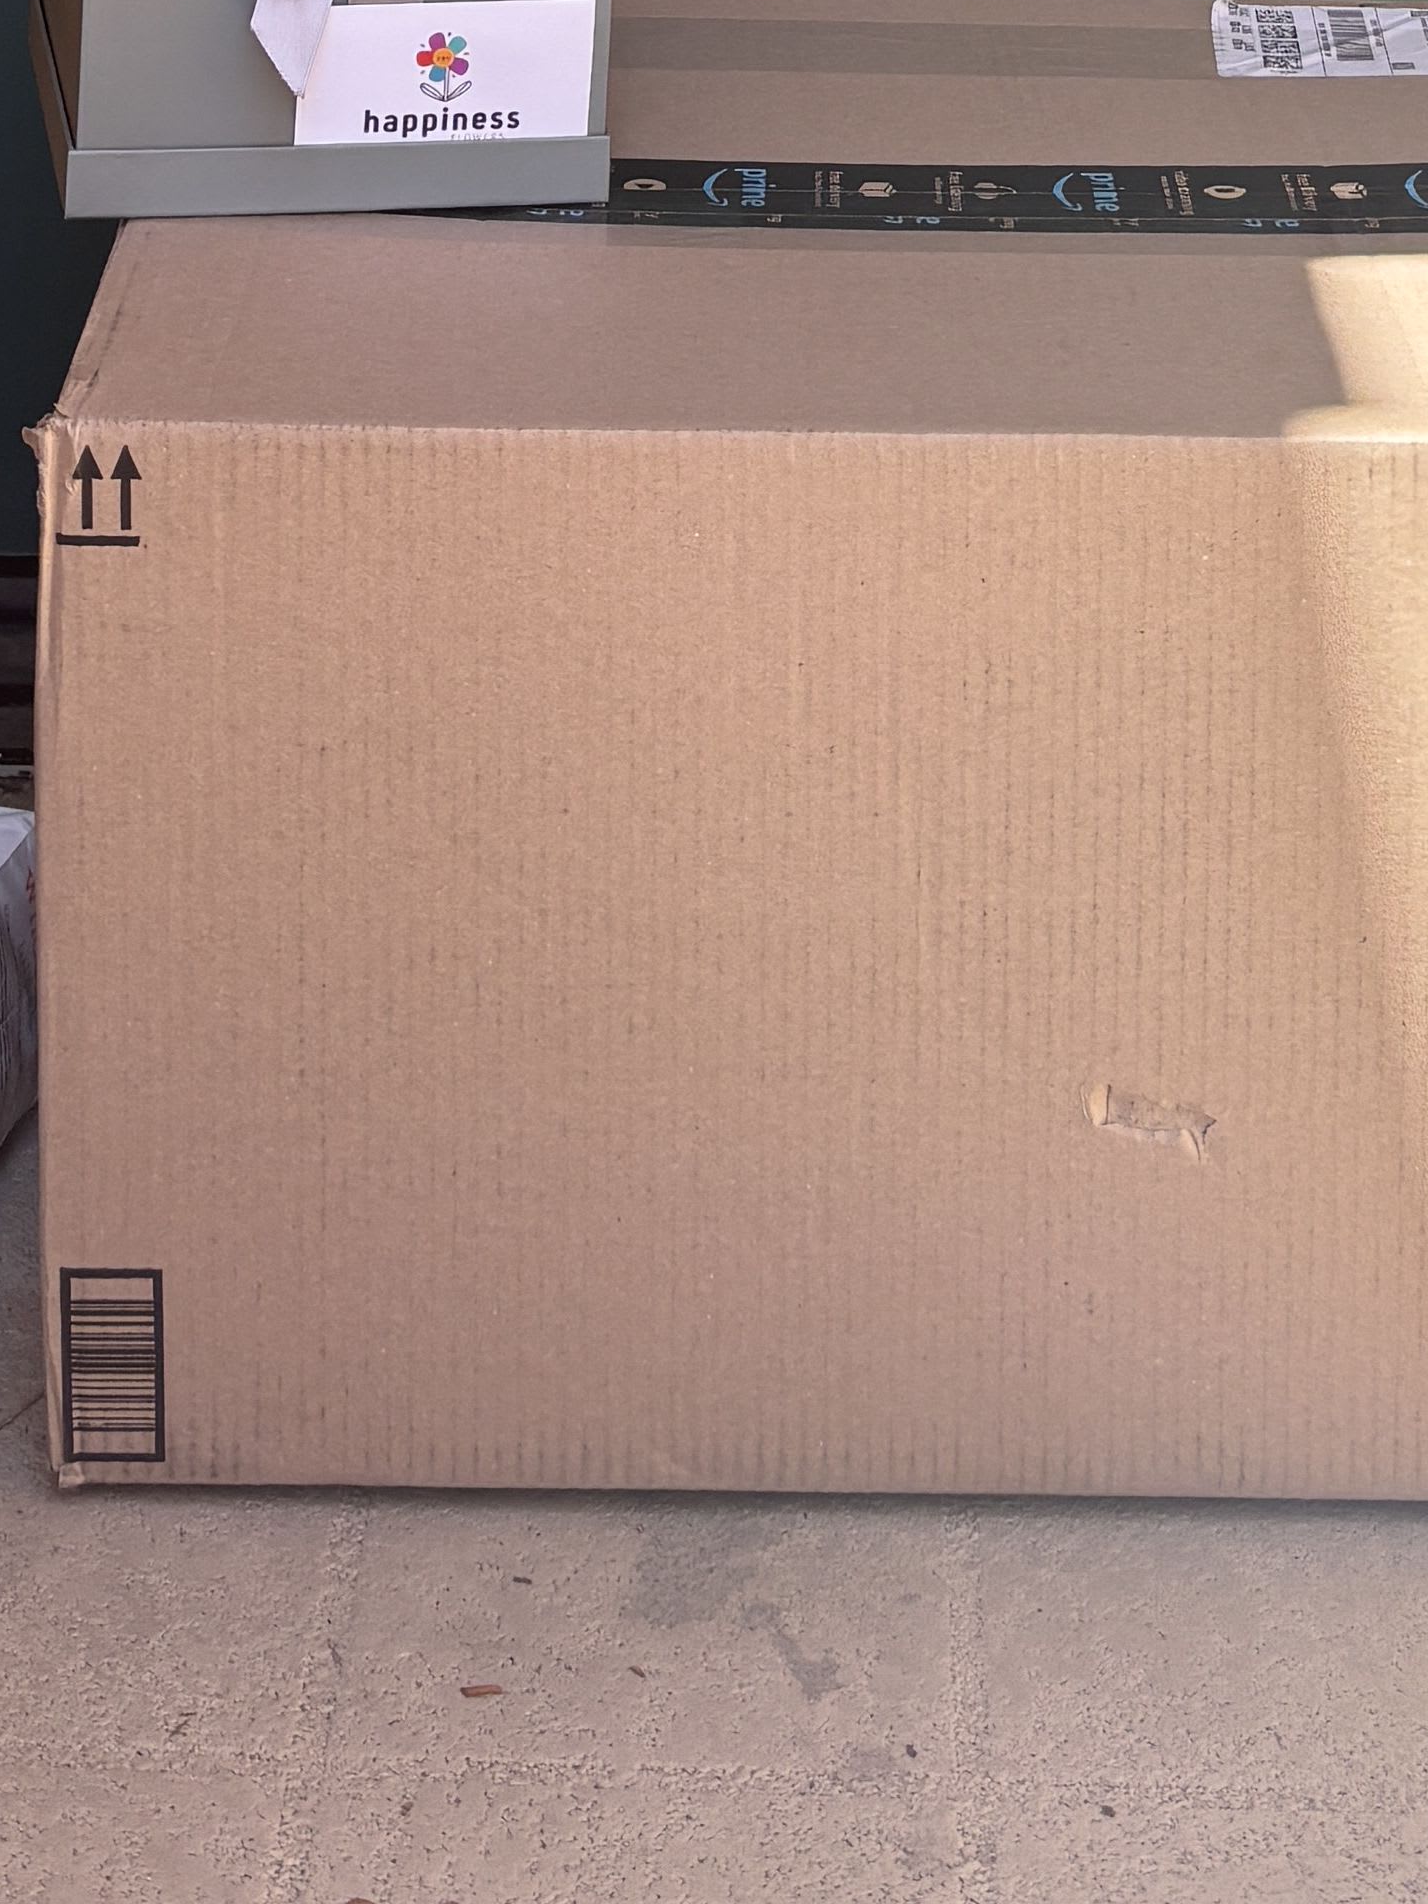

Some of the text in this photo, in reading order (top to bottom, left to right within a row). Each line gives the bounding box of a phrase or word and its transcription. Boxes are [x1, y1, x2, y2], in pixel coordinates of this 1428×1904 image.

[363, 106, 521, 138] happiness
[734, 168, 776, 207] prime
[1080, 172, 1125, 211] prime
